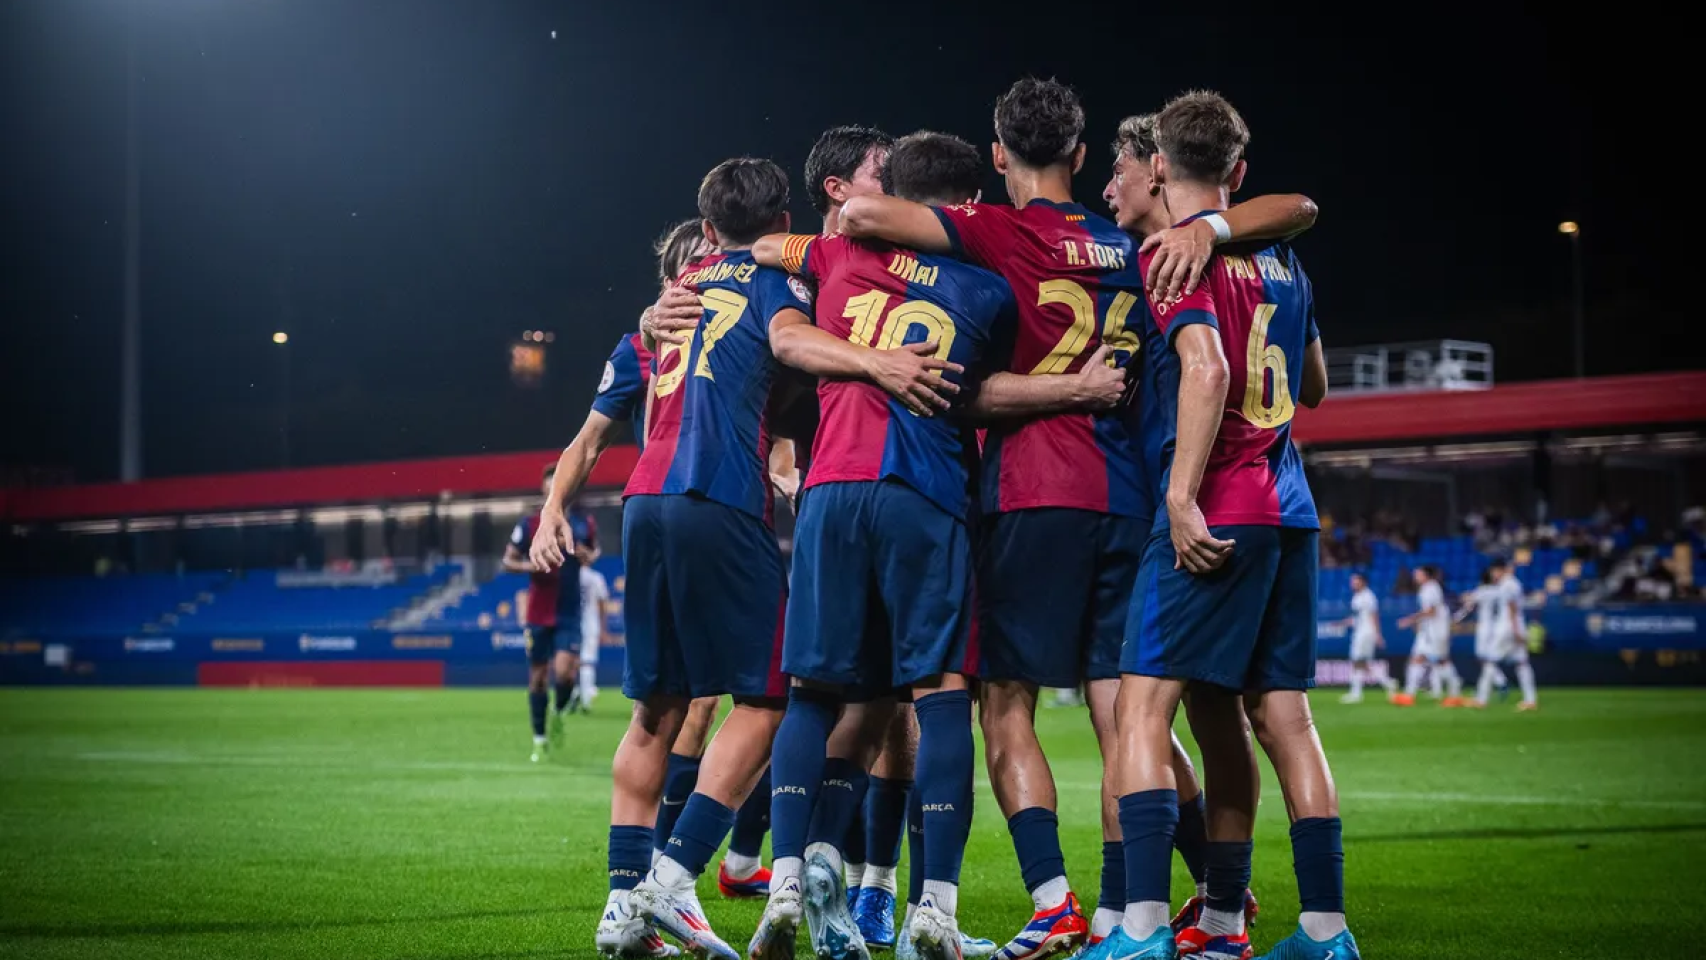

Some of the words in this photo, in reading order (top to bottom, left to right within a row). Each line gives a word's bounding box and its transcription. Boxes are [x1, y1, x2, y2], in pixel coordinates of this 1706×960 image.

[1065, 241, 1085, 265] H.
[1224, 256, 1256, 280] PAU
[887, 254, 939, 287] UNAI
[1029, 278, 1140, 374] 26
[1241, 303, 1296, 429] 6
